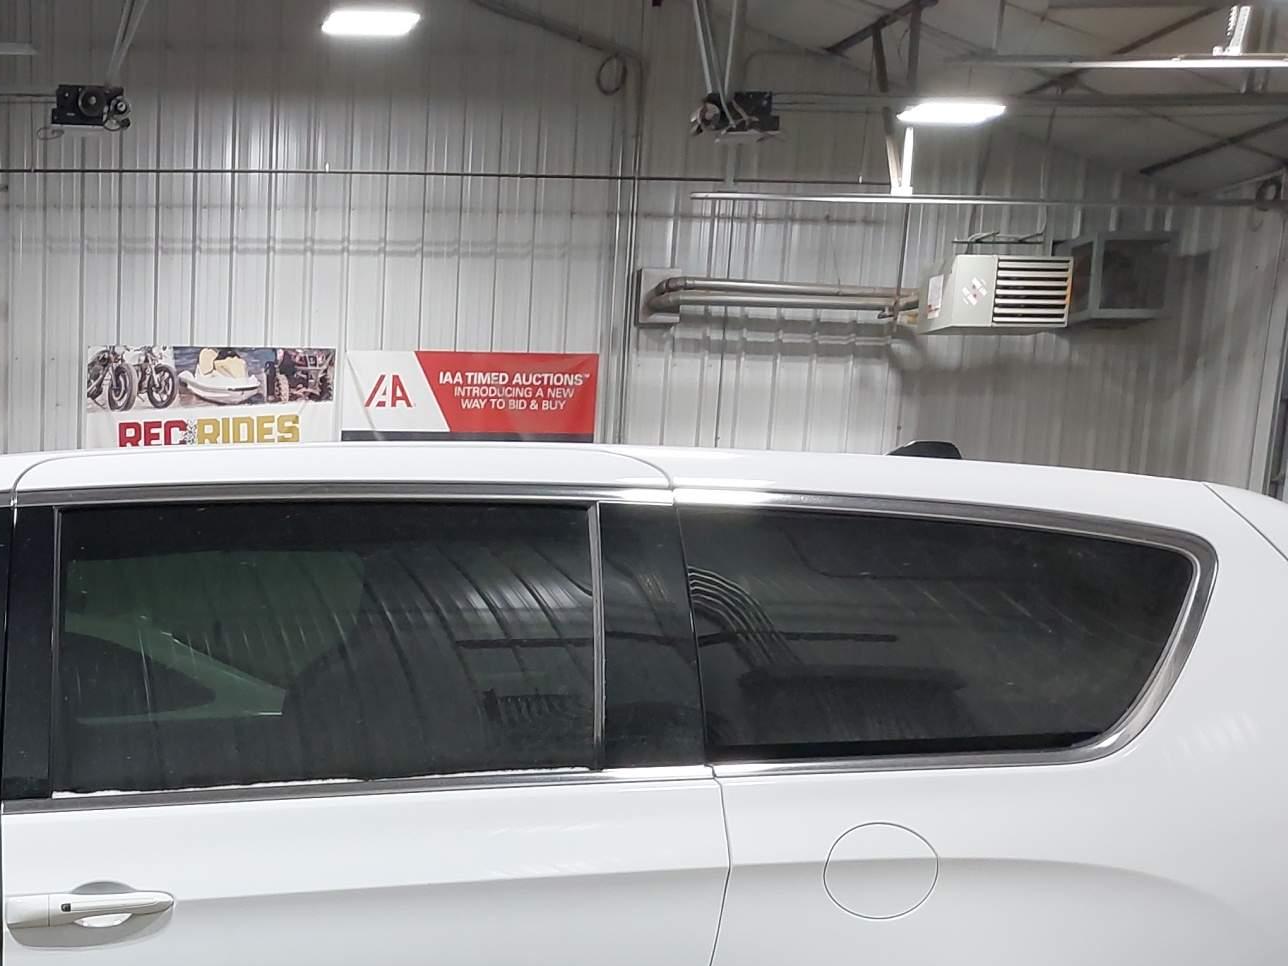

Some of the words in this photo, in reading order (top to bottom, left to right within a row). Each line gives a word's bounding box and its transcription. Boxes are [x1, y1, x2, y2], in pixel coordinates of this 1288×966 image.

[439, 371, 463, 385] IAA
[465, 371, 509, 385] TIMED
[454, 386, 533, 398] INTRODUCING
[535, 387, 544, 398] A
[547, 387, 575, 398] NEW
[460, 398, 488, 409] WAY
[490, 399, 506, 410] TO
[509, 399, 527, 410] BID
[529, 399, 539, 410] &
[542, 400, 566, 410] BUY
[118, 419, 188, 447] REC
[197, 413, 300, 445] RIDES
